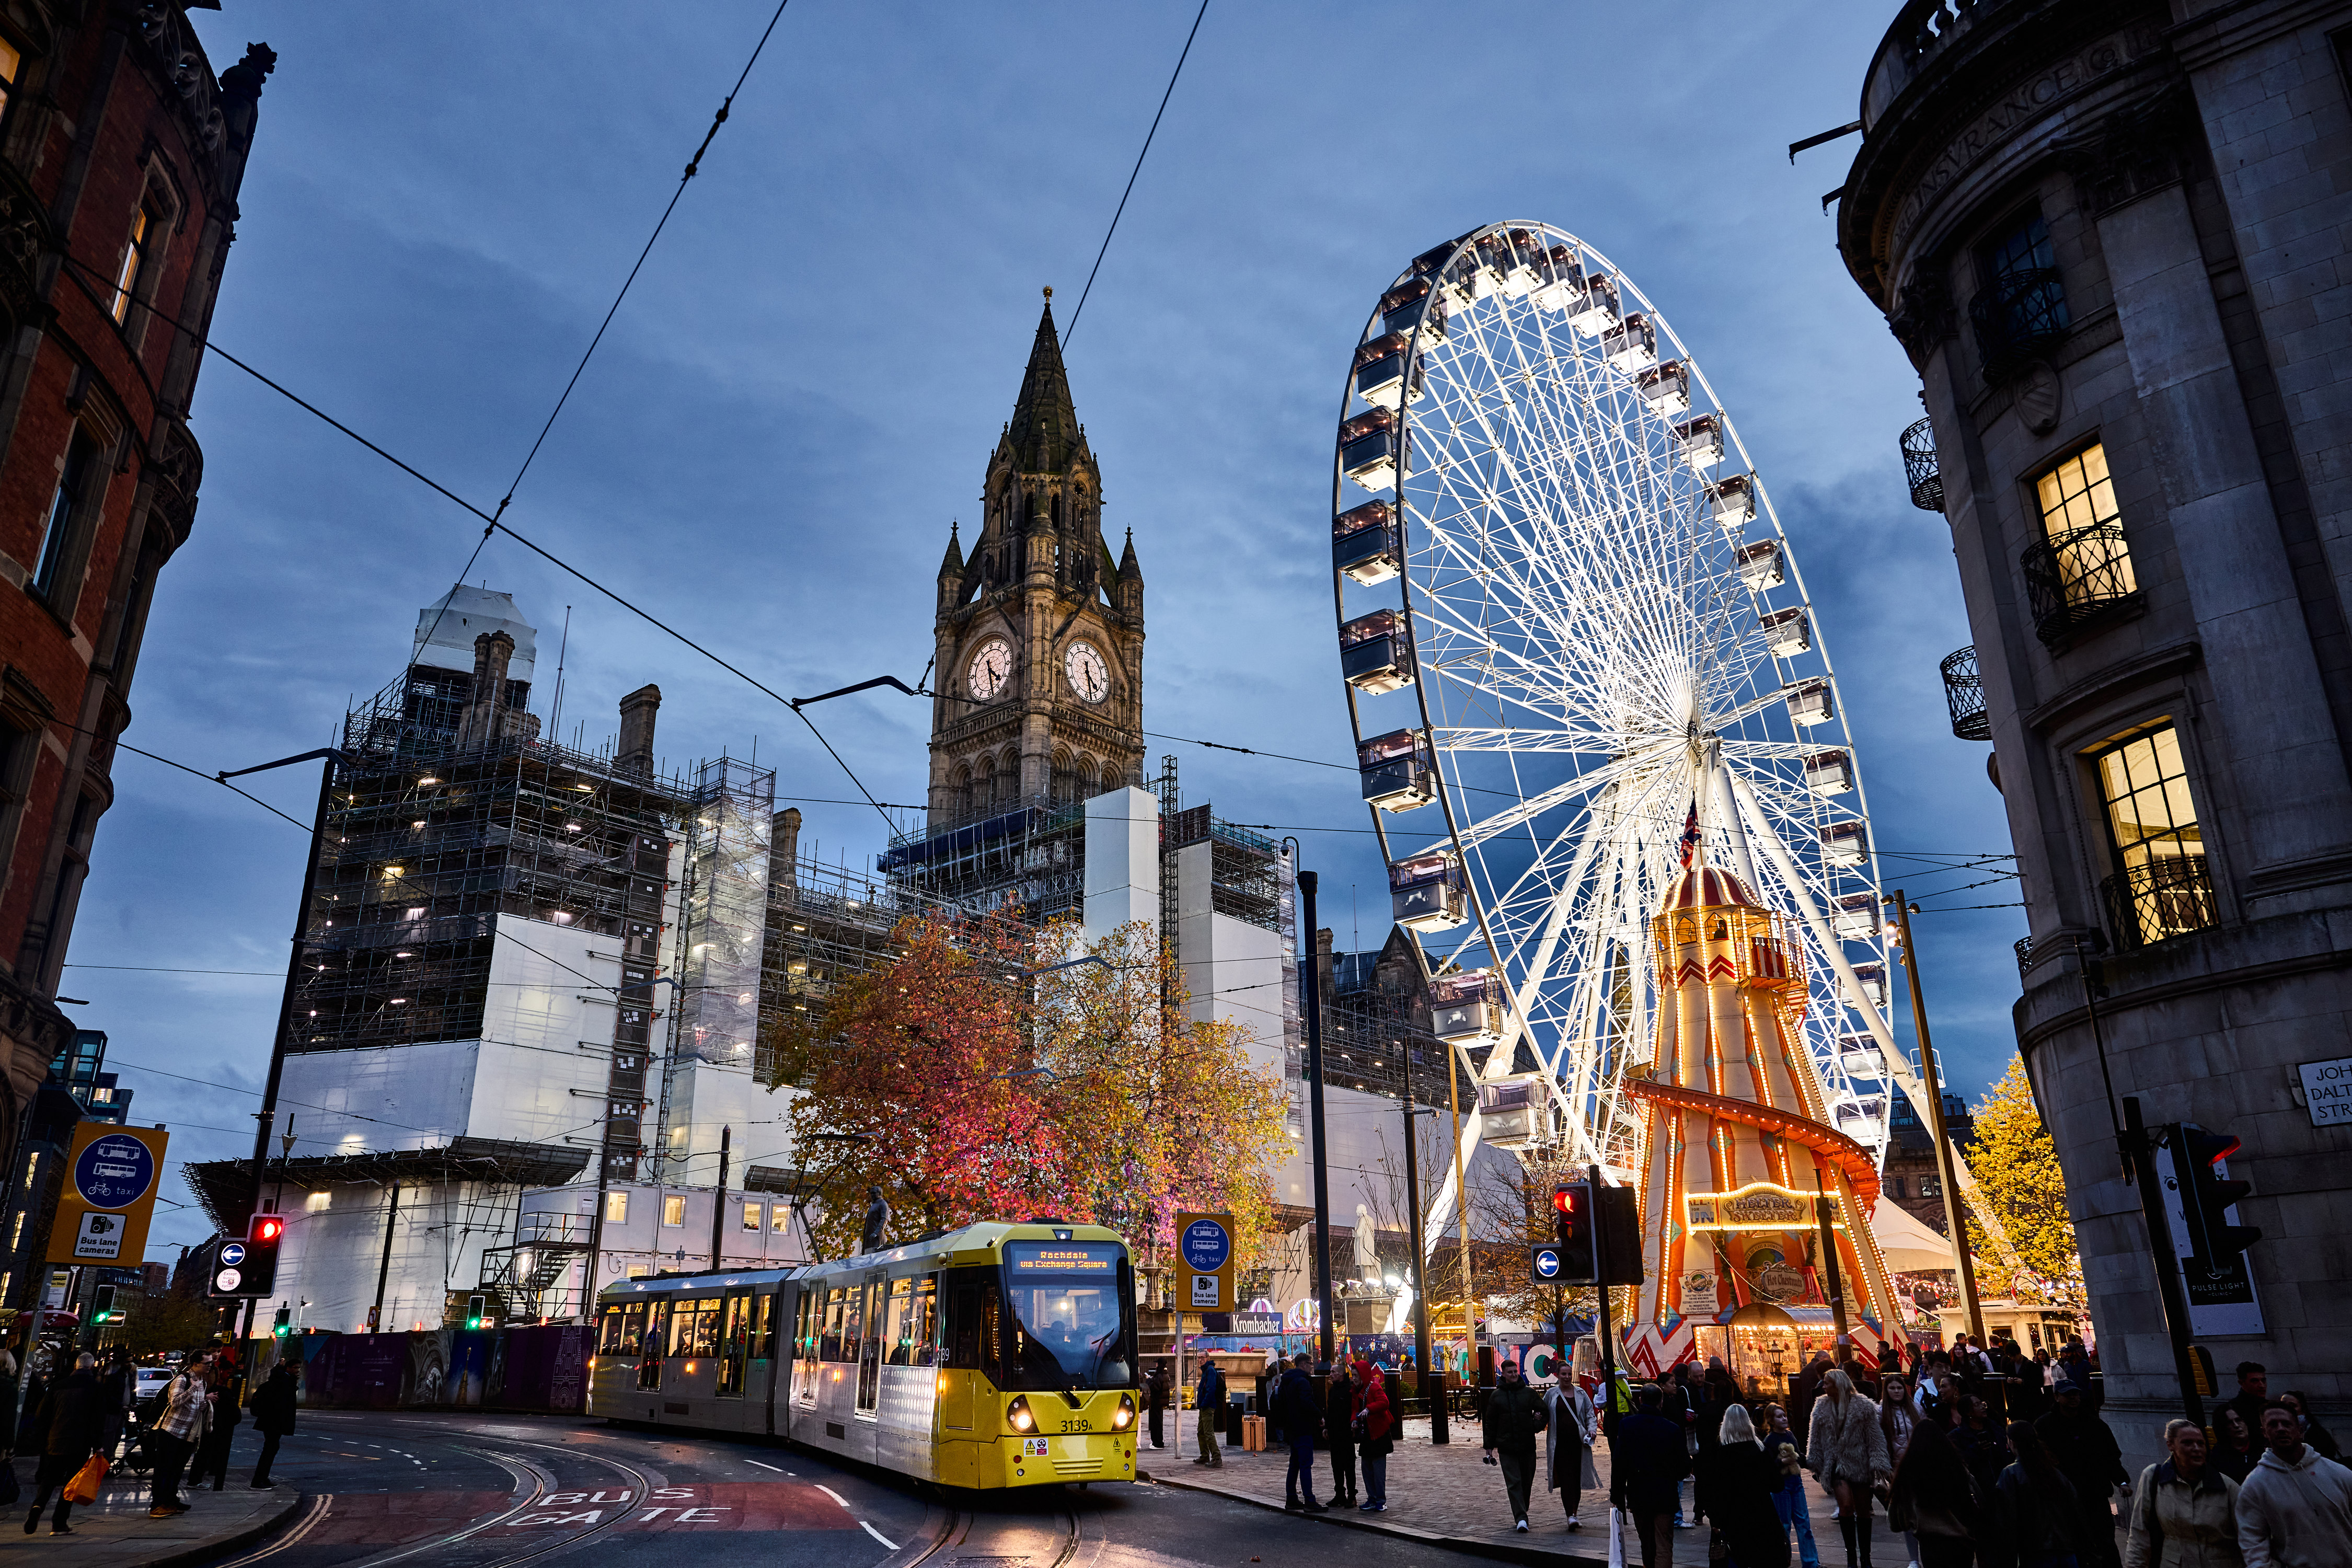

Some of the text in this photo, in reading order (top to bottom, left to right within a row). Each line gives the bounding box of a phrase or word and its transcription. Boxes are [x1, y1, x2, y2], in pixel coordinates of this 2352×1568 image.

[2318, 1102, 2352, 1118] STR
[117, 1186, 134, 1195] taxi
[1735, 1197, 1794, 1209] HELTER
[1690, 1211, 1714, 1224] UN
[1733, 1210, 1799, 1223] SKELTER
[80, 1237, 97, 1245] Bus
[79, 1246, 115, 1255] cameras
[1035, 1261, 1076, 1269] Exchange
[1078, 1261, 1108, 1269] Square
[1767, 1275, 1777, 1286] Hot
[1778, 1274, 1803, 1288] Chestnuts
[2192, 1282, 2245, 1292] PULSE LIGHT
[1232, 1314, 1280, 1333] Krombacher
[1060, 1419, 1093, 1433] 3139A
[536, 1488, 695, 1506] BUS
[506, 1507, 732, 1526] GATE
